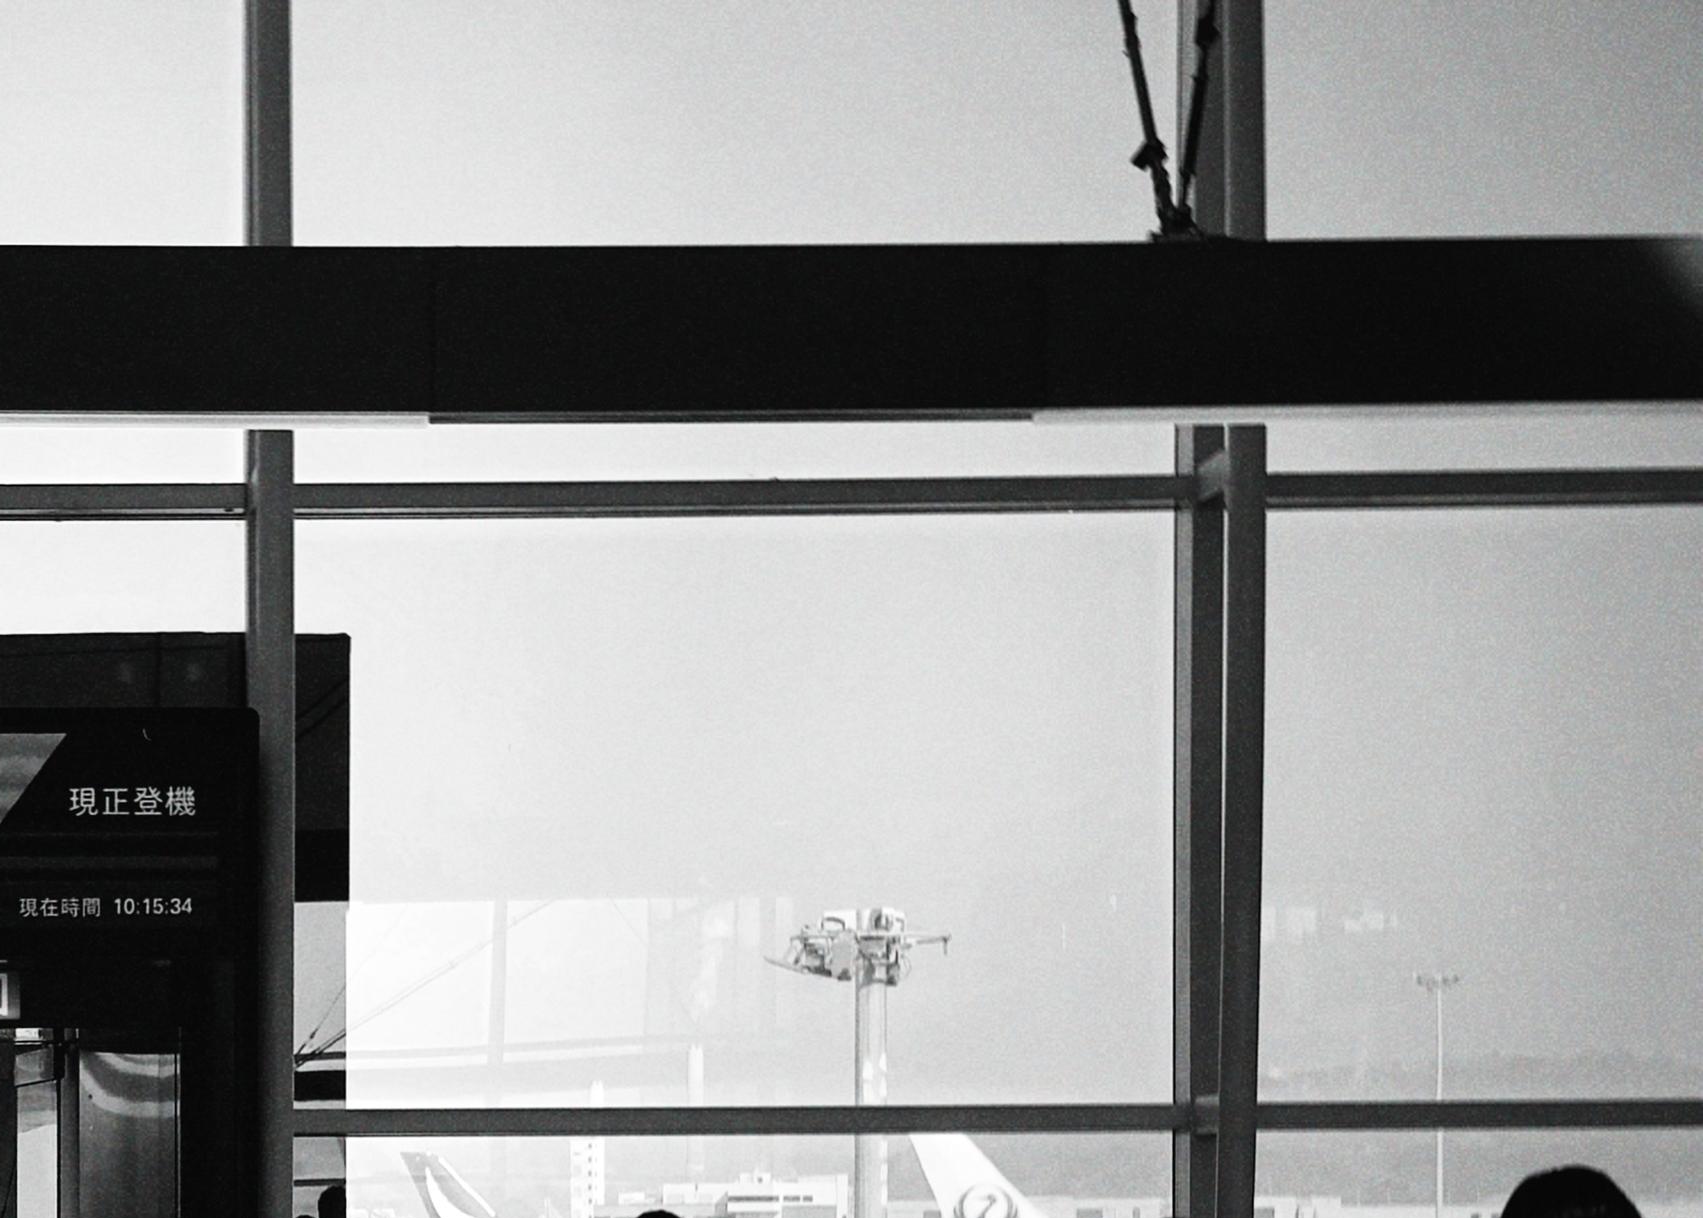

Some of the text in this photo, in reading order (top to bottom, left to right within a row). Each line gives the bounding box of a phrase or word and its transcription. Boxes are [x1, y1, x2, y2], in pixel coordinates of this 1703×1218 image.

[68, 785, 197, 817] 現正登機
[19, 897, 193, 918] 現在時間 10:15:34
